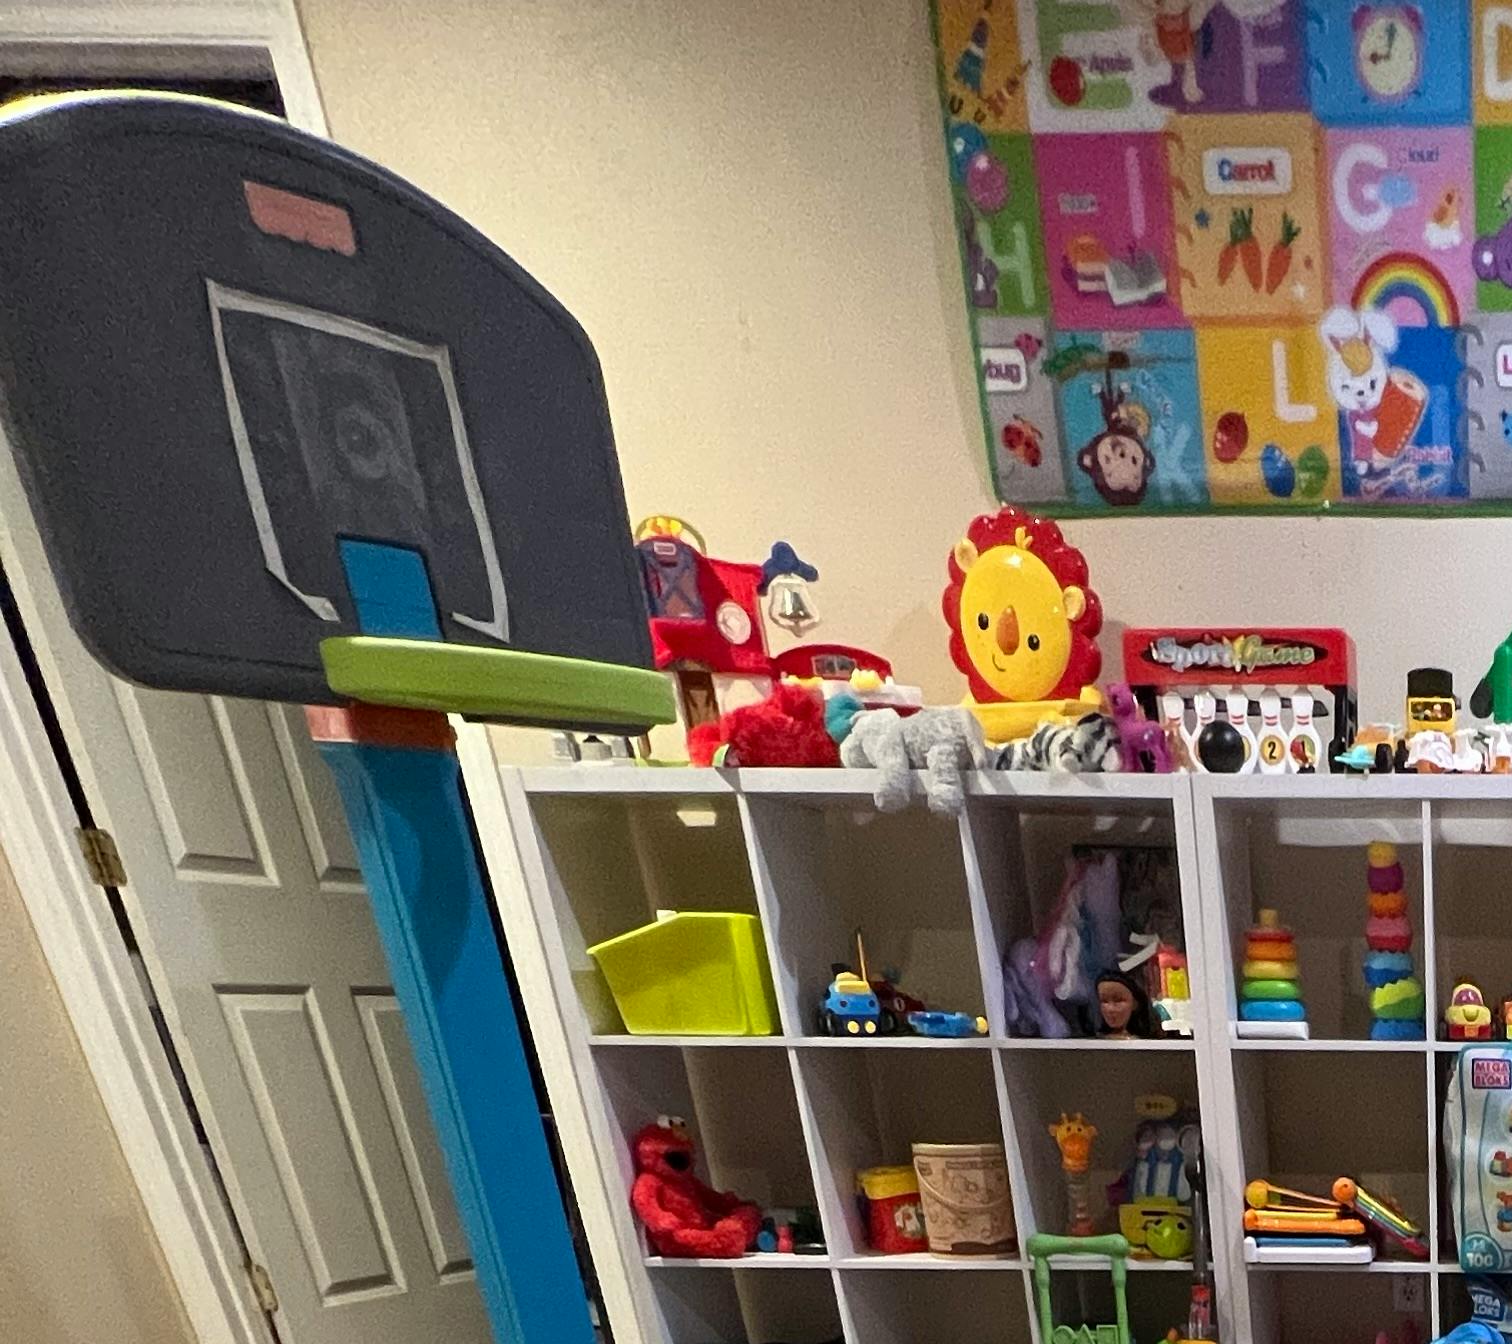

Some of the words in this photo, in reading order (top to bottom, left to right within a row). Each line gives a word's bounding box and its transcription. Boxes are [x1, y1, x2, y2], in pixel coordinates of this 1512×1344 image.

[1216, 158, 1277, 182] Carrot
[1332, 142, 1400, 233] G
[1270, 338, 1319, 423] L
[1268, 740, 1277, 761] 2
